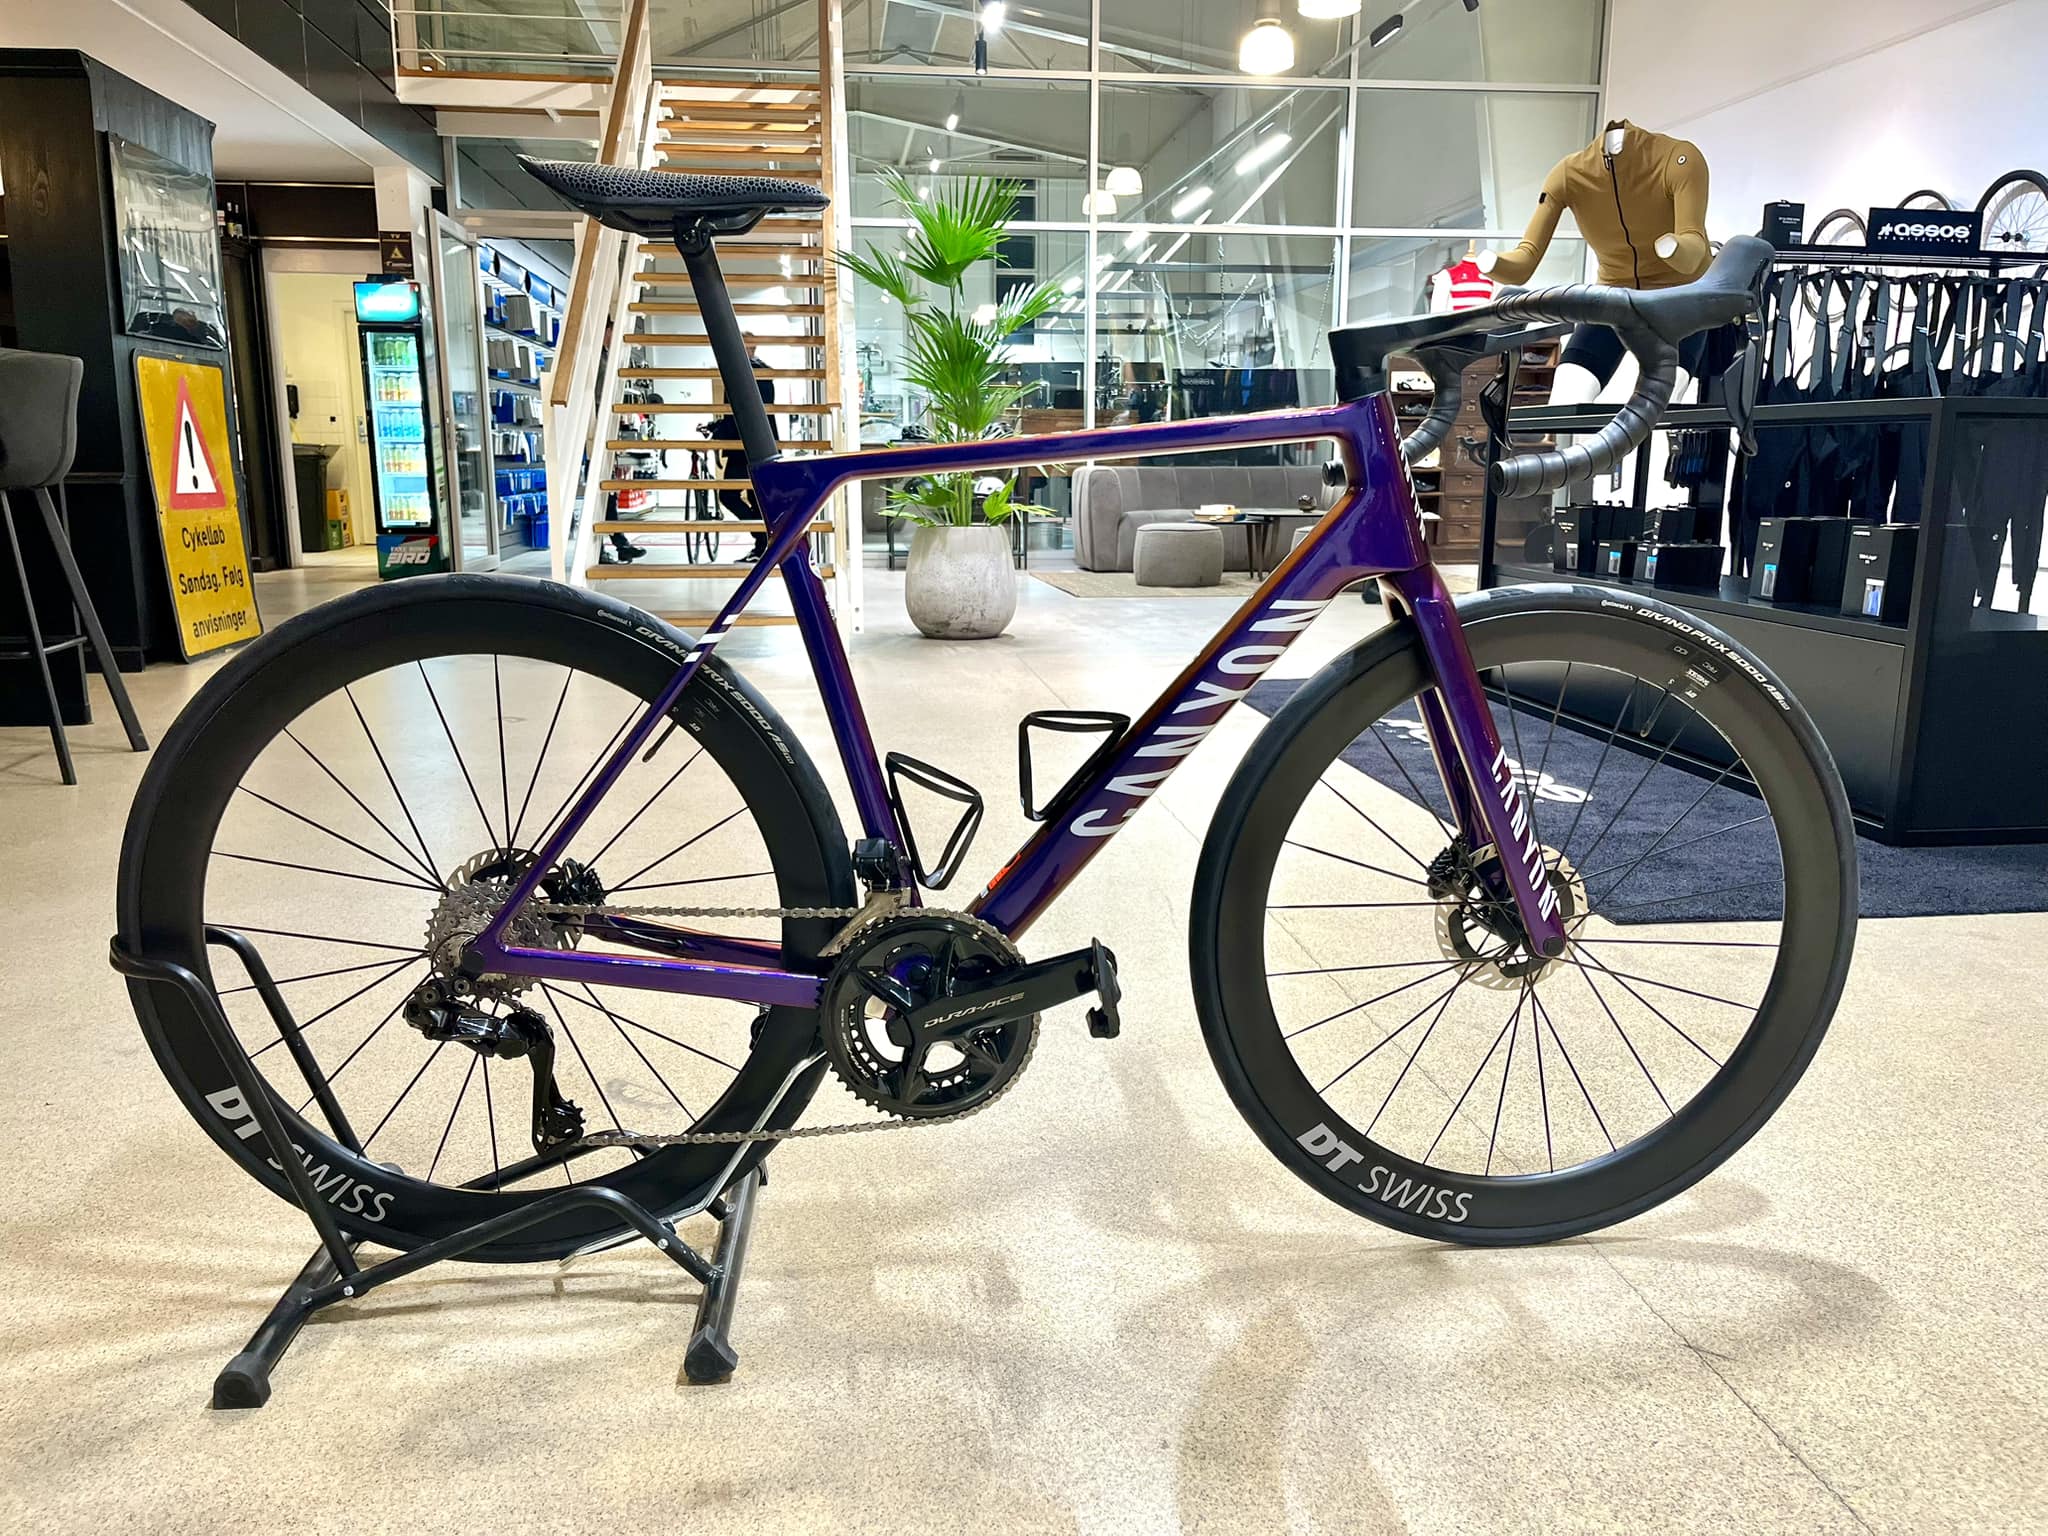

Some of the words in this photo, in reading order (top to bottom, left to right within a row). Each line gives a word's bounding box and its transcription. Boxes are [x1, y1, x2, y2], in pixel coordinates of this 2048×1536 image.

[182, 525, 225, 552] Cykelløb
[179, 568, 221, 595] Søndag.
[222, 564, 245, 588] Følg
[193, 610, 247, 638] anvisninger
[635, 626, 690, 659] GRAN
[1636, 608, 1694, 633] GRAND
[1690, 630, 1730, 654] PRIX
[1725, 651, 1768, 684] 5000
[1070, 599, 1333, 837] CANYON
[1490, 745, 1560, 922] CANYON
[924, 992, 1026, 1029] DURA-ACE
[1295, 1121, 1365, 1173] DT
[1357, 1165, 1473, 1224] SWISS
